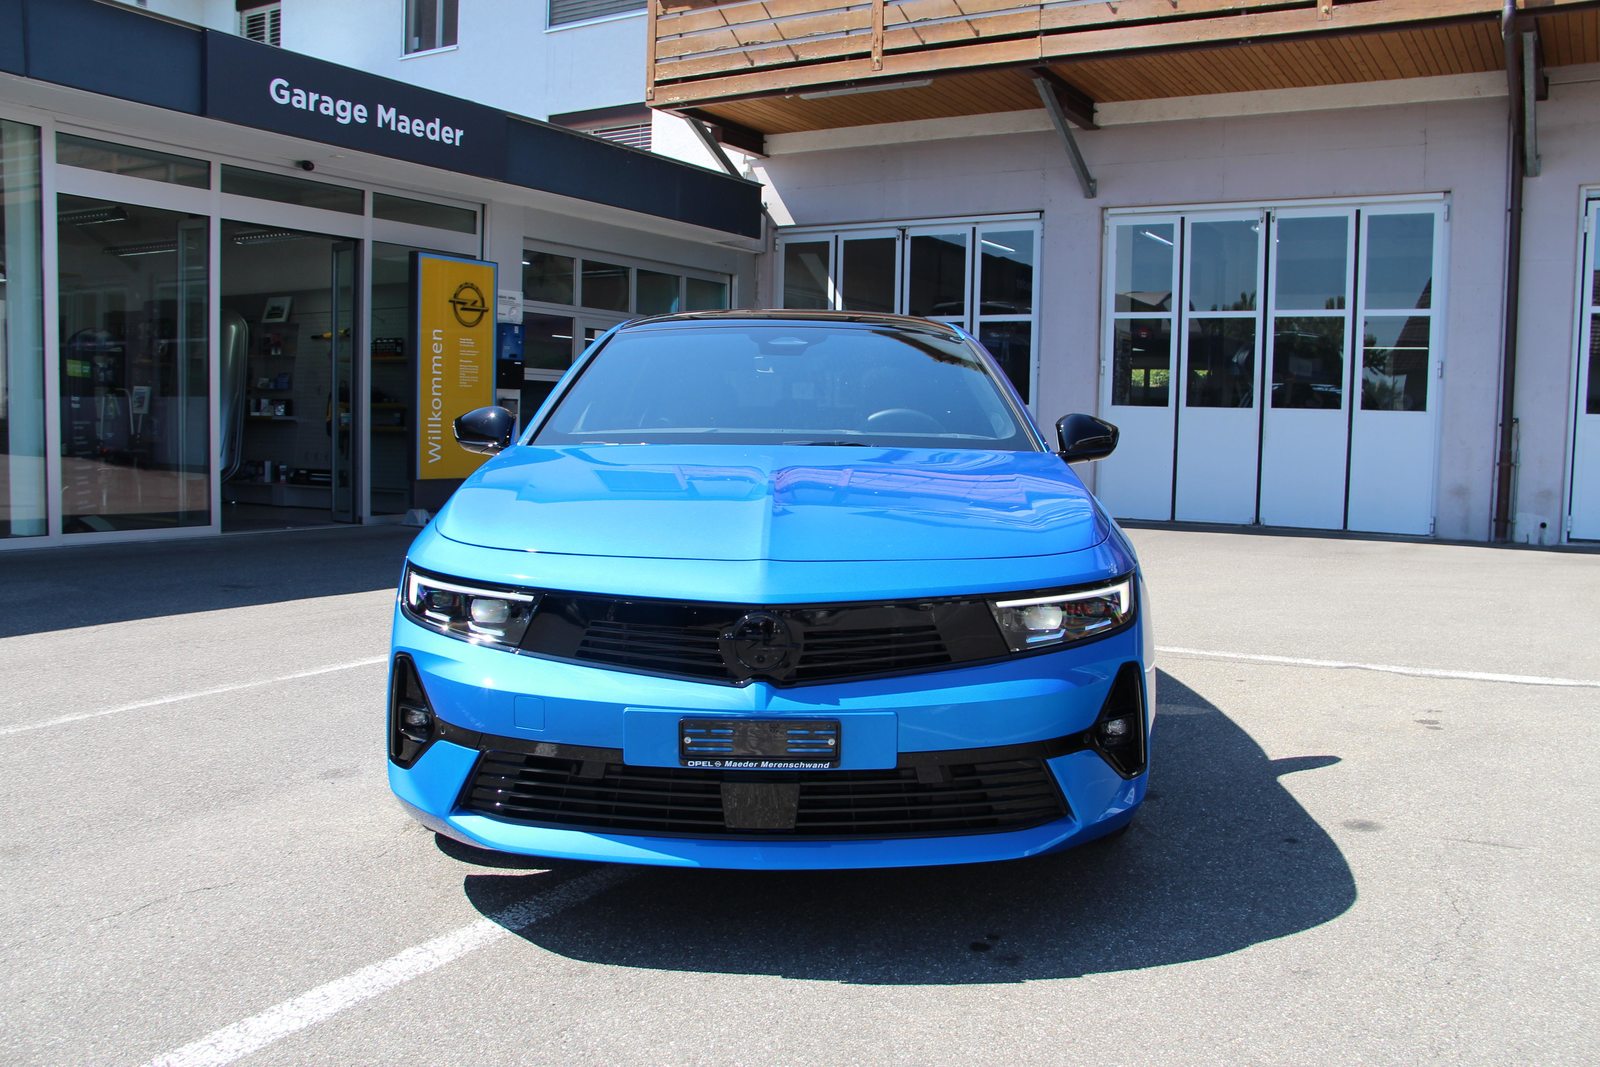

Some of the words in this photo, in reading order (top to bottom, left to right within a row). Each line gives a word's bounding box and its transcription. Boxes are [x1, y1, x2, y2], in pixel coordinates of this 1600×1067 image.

[269, 77, 368, 125] Garage
[376, 103, 464, 146] Maeder
[427, 329, 443, 464] Willkommen
[724, 760, 758, 768] Maeder
[760, 760, 830, 769] Merenschwand
